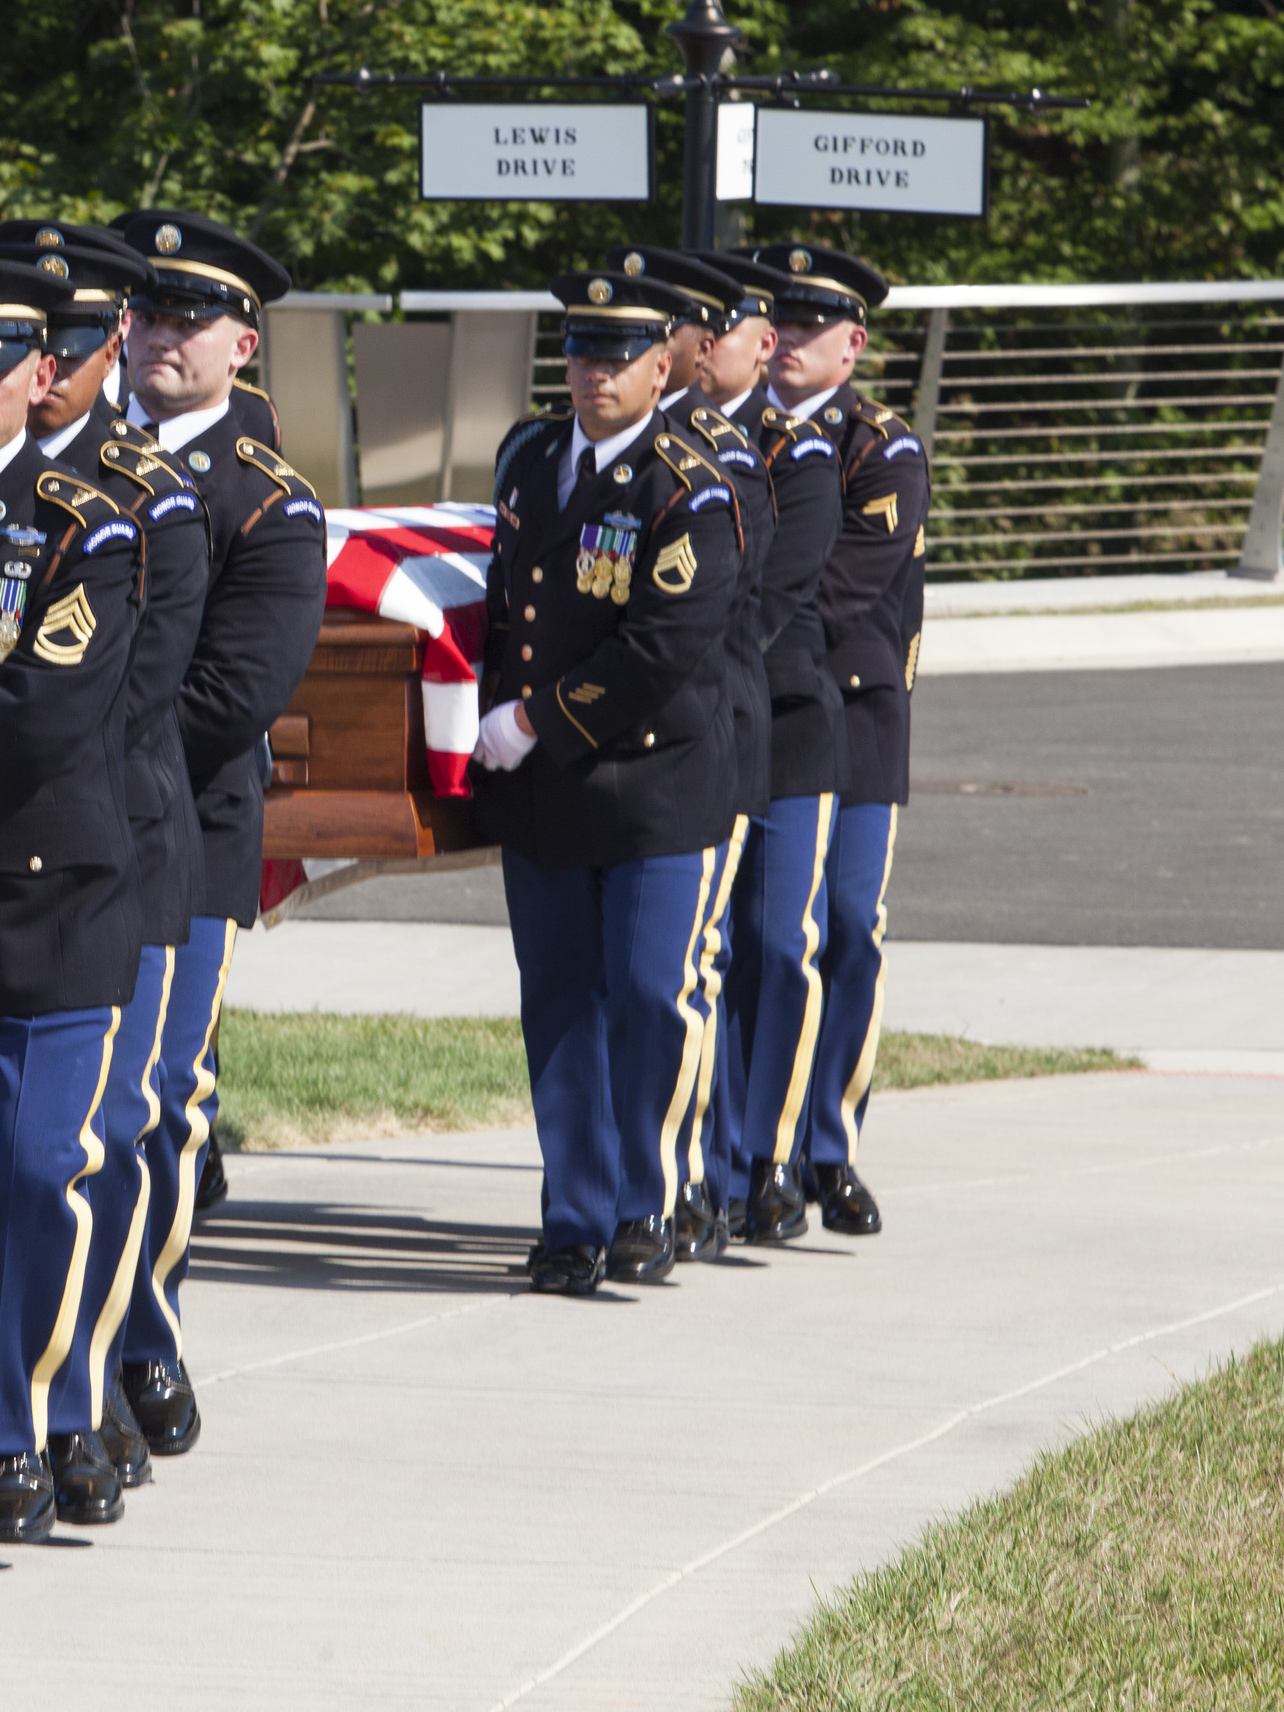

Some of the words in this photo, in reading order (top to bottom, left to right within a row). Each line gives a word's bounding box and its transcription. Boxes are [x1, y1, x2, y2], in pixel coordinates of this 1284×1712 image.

[494, 126, 577, 145] LEWIS
[813, 134, 926, 158] GIFFORD
[497, 158, 576, 176] DRIVE
[830, 166, 910, 188] DRIVE
[152, 496, 176, 519] HONOR
[176, 495, 195, 511] GUARD
[286, 500, 308, 517] HONOR
[86, 525, 111, 553] HONOR
[111, 523, 134, 540] GUARD
